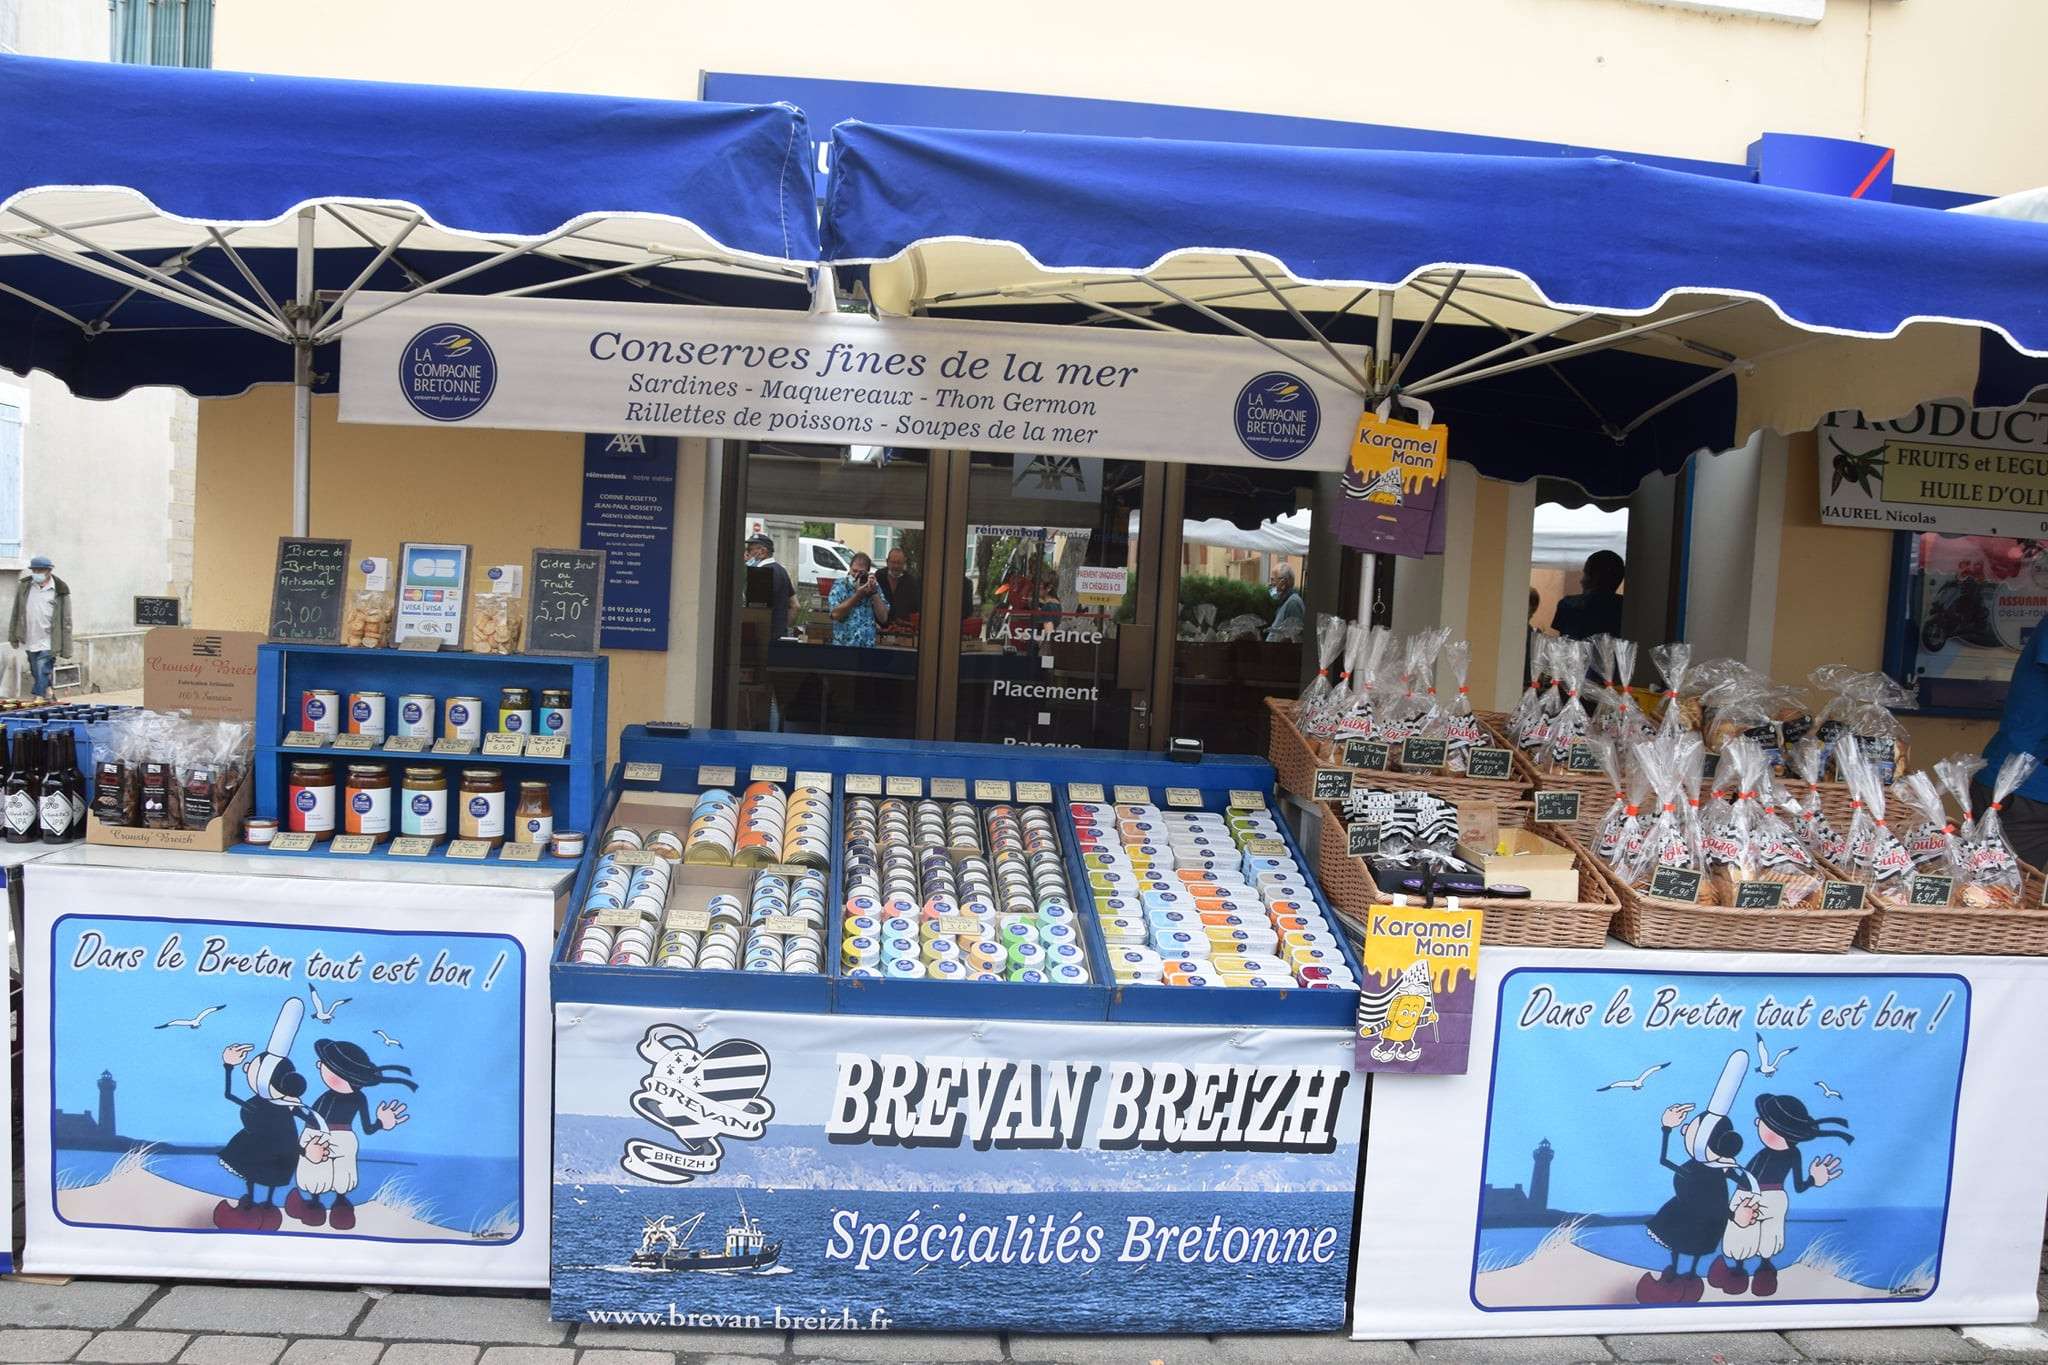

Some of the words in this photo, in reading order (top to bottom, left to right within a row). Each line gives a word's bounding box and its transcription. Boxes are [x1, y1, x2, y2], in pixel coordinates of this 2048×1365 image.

[415, 348, 432, 361] LA
[590, 332, 811, 370] Conserves
[816, 343, 927, 377] fines
[940, 350, 990, 380] de
[1003, 353, 1044, 383] la
[1056, 361, 1139, 388] mer
[414, 363, 481, 379] COMPAGNIE
[414, 379, 480, 394] BRETONNE
[628, 373, 738, 397] Sardines
[760, 379, 914, 406] Maquereaux
[935, 388, 995, 410] Thon
[1003, 392, 1097, 416] Germon
[1248, 393, 1263, 406] LA
[625, 402, 726, 425] Rillettes
[733, 407, 762, 426] de
[768, 409, 873, 433] poissons
[895, 415, 981, 440] Soupes
[987, 419, 1016, 439] de
[1023, 421, 1046, 441] la
[1052, 428, 1098, 444] mer
[1247, 407, 1307, 423] COMPAGNIE
[1247, 421, 1306, 437] BRETONNE
[605, 434, 646, 453] AXA
[1360, 429, 1438, 454] Karamel
[1392, 450, 1434, 469] Mann
[1898, 448, 1969, 469] FRUITS
[1975, 458, 1991, 472] et
[1920, 480, 1983, 500] HUILE
[1822, 503, 1882, 521] MAUREL
[1885, 510, 1937, 525] Nicolas
[280, 560, 343, 577] Bretagne
[540, 559, 570, 570] Cidre
[281, 574, 336, 586] Artisanale
[405, 603, 421, 611] VISA
[995, 623, 1104, 645] Assurance
[992, 679, 1099, 701] Placement
[1373, 915, 1473, 939] Karamel
[1416, 938, 1470, 957] Mann
[73, 932, 144, 968] Dans
[155, 936, 184, 968] le
[199, 937, 291, 979] Breton
[307, 951, 363, 981] tout
[372, 957, 417, 982] est
[426, 952, 471, 986] bon
[485, 953, 506, 990] !
[1519, 987, 1593, 1029] Dans
[1603, 987, 1633, 1025] le
[1645, 987, 1739, 1029] Breton
[1756, 996, 1808, 1027] tout
[1819, 1000, 1865, 1028] est
[1873, 994, 1918, 1030] bon
[1927, 994, 1953, 1033] !
[653, 1080, 751, 1132] BREVAN
[825, 1052, 1101, 1151] BREVAN
[1097, 1060, 1350, 1154] BREIZH
[654, 1151, 706, 1169] BREIZH
[825, 1209, 1103, 1271] Spécialités
[1117, 1214, 1339, 1266] Bretonne
[587, 1303, 893, 1332] www.brevan-breizh.fr
